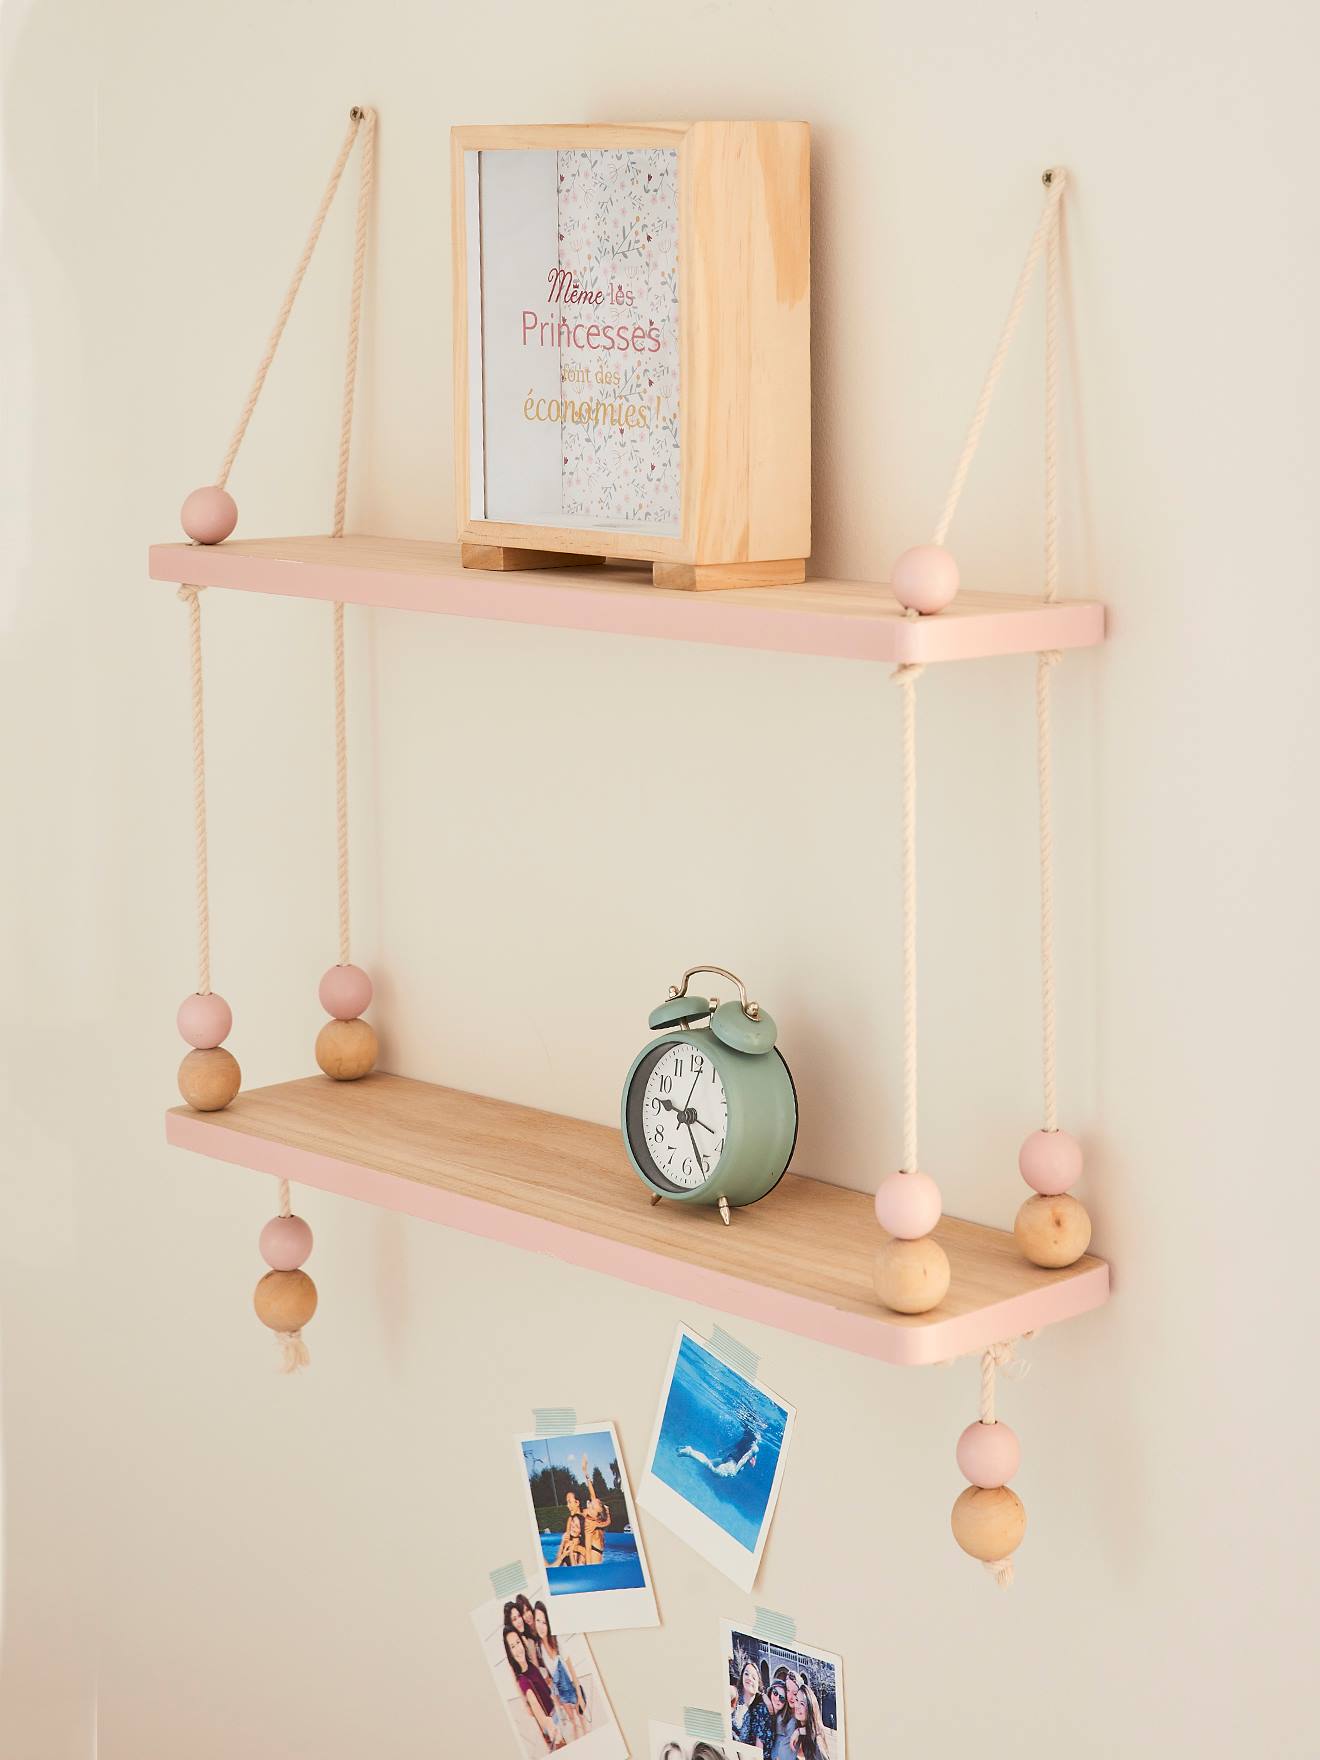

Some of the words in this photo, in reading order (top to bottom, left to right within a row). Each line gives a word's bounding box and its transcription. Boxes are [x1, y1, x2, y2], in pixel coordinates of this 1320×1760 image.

[608, 282, 634, 306] les
[522, 311, 661, 353] Princesses
[595, 366, 621, 385] des
[523, 388, 648, 428] économies
[655, 396, 662, 429] !
[674, 1059, 683, 1077] 11
[690, 1055, 704, 1073] 12
[660, 1075, 672, 1093] 10
[712, 1067, 716, 1083] 1
[652, 1097, 661, 1116] 9
[655, 1125, 664, 1143] 8
[668, 1146, 677, 1164] 7
[701, 1155, 710, 1173] 5
[682, 1158, 692, 1175] 6
